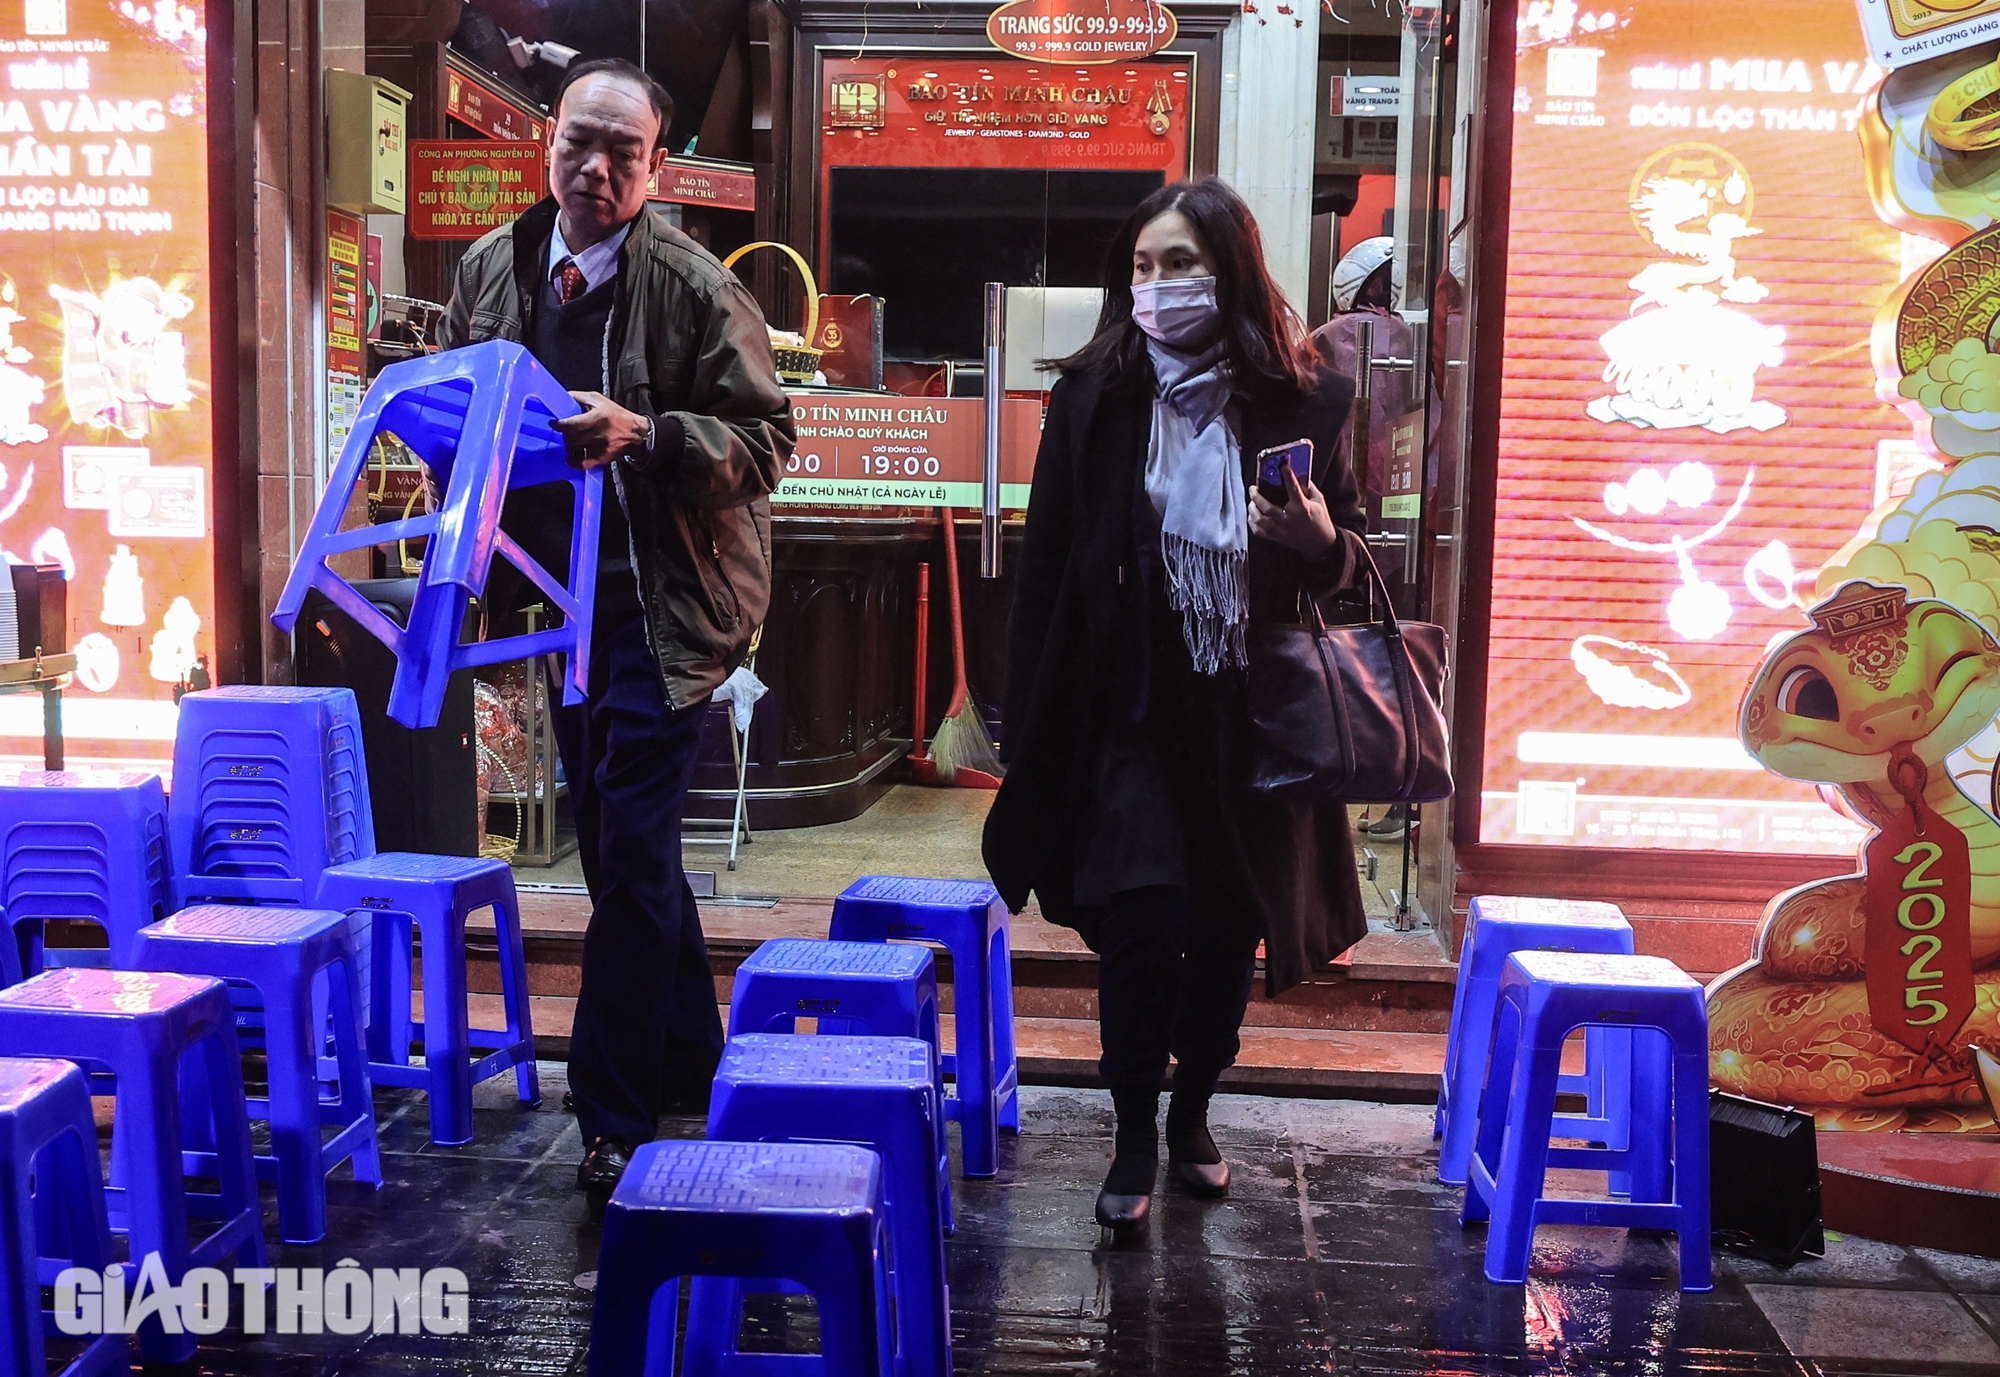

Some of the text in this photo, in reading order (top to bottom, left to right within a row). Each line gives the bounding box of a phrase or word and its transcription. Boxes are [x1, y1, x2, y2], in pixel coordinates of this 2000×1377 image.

[998, 16, 1050, 35] TRANG
[1053, 12, 1084, 35] SỨC
[1912, 10, 1932, 21] 2013
[1931, 30, 1968, 47] LƯỢNG
[1969, 20, 1999, 35] VÀNG
[1015, 41, 1036, 51] 99.9
[1045, 41, 1071, 51] 999.9
[1073, 41, 1102, 52] GOLD
[1104, 41, 1148, 53] JEWELRY
[1709, 58, 1812, 92] MUA
[1822, 57, 1882, 94] VÀ
[1004, 84, 1063, 103] MINH
[1071, 83, 1132, 105] CHÂU
[1345, 97, 1366, 105] VÀNG
[40, 94, 166, 133] VÀNG
[1629, 102, 1691, 127] ĐÓN
[980, 130, 1023, 138] GEMSTONES
[1028, 130, 1064, 139] DIAMOND
[1069, 131, 1090, 139] GOLD
[81, 138, 152, 176] TÀI
[418, 147, 535, 159] CÔNG AN PHƯỜNG NGUYỄN DU
[446, 170, 470, 186] NGHỊ
[472, 167, 499, 183] NHÂN
[501, 167, 522, 183] DÂN
[697, 176, 711, 188] TÍN
[418, 189, 437, 204] CHÚ
[439, 188, 446, 204] Ý
[498, 188, 514, 204] TÀI
[516, 186, 536, 204] SẢN
[673, 186, 717, 199] MINH CHÂU
[0, 211, 50, 231] ANG
[431, 210, 458, 226] KHÓA
[460, 211, 472, 226] XE
[810, 403, 842, 422] TÍN
[844, 407, 893, 423] MINH
[897, 406, 948, 424] CHÂU
[819, 426, 855, 438] CHÀO
[857, 426, 882, 440] QUÝ
[885, 427, 928, 440] KHÁCH
[785, 454, 941, 476] 00 19:00
[783, 483, 806, 496] ĐẾN
[809, 484, 834, 496] CHỦ
[837, 485, 869, 499] NHẬT
[872, 485, 890, 498] (CẢ
[894, 486, 926, 499] NGÀY
[929, 486, 946, 500] LỄ)
[1893, 841, 1948, 1026] 2025
